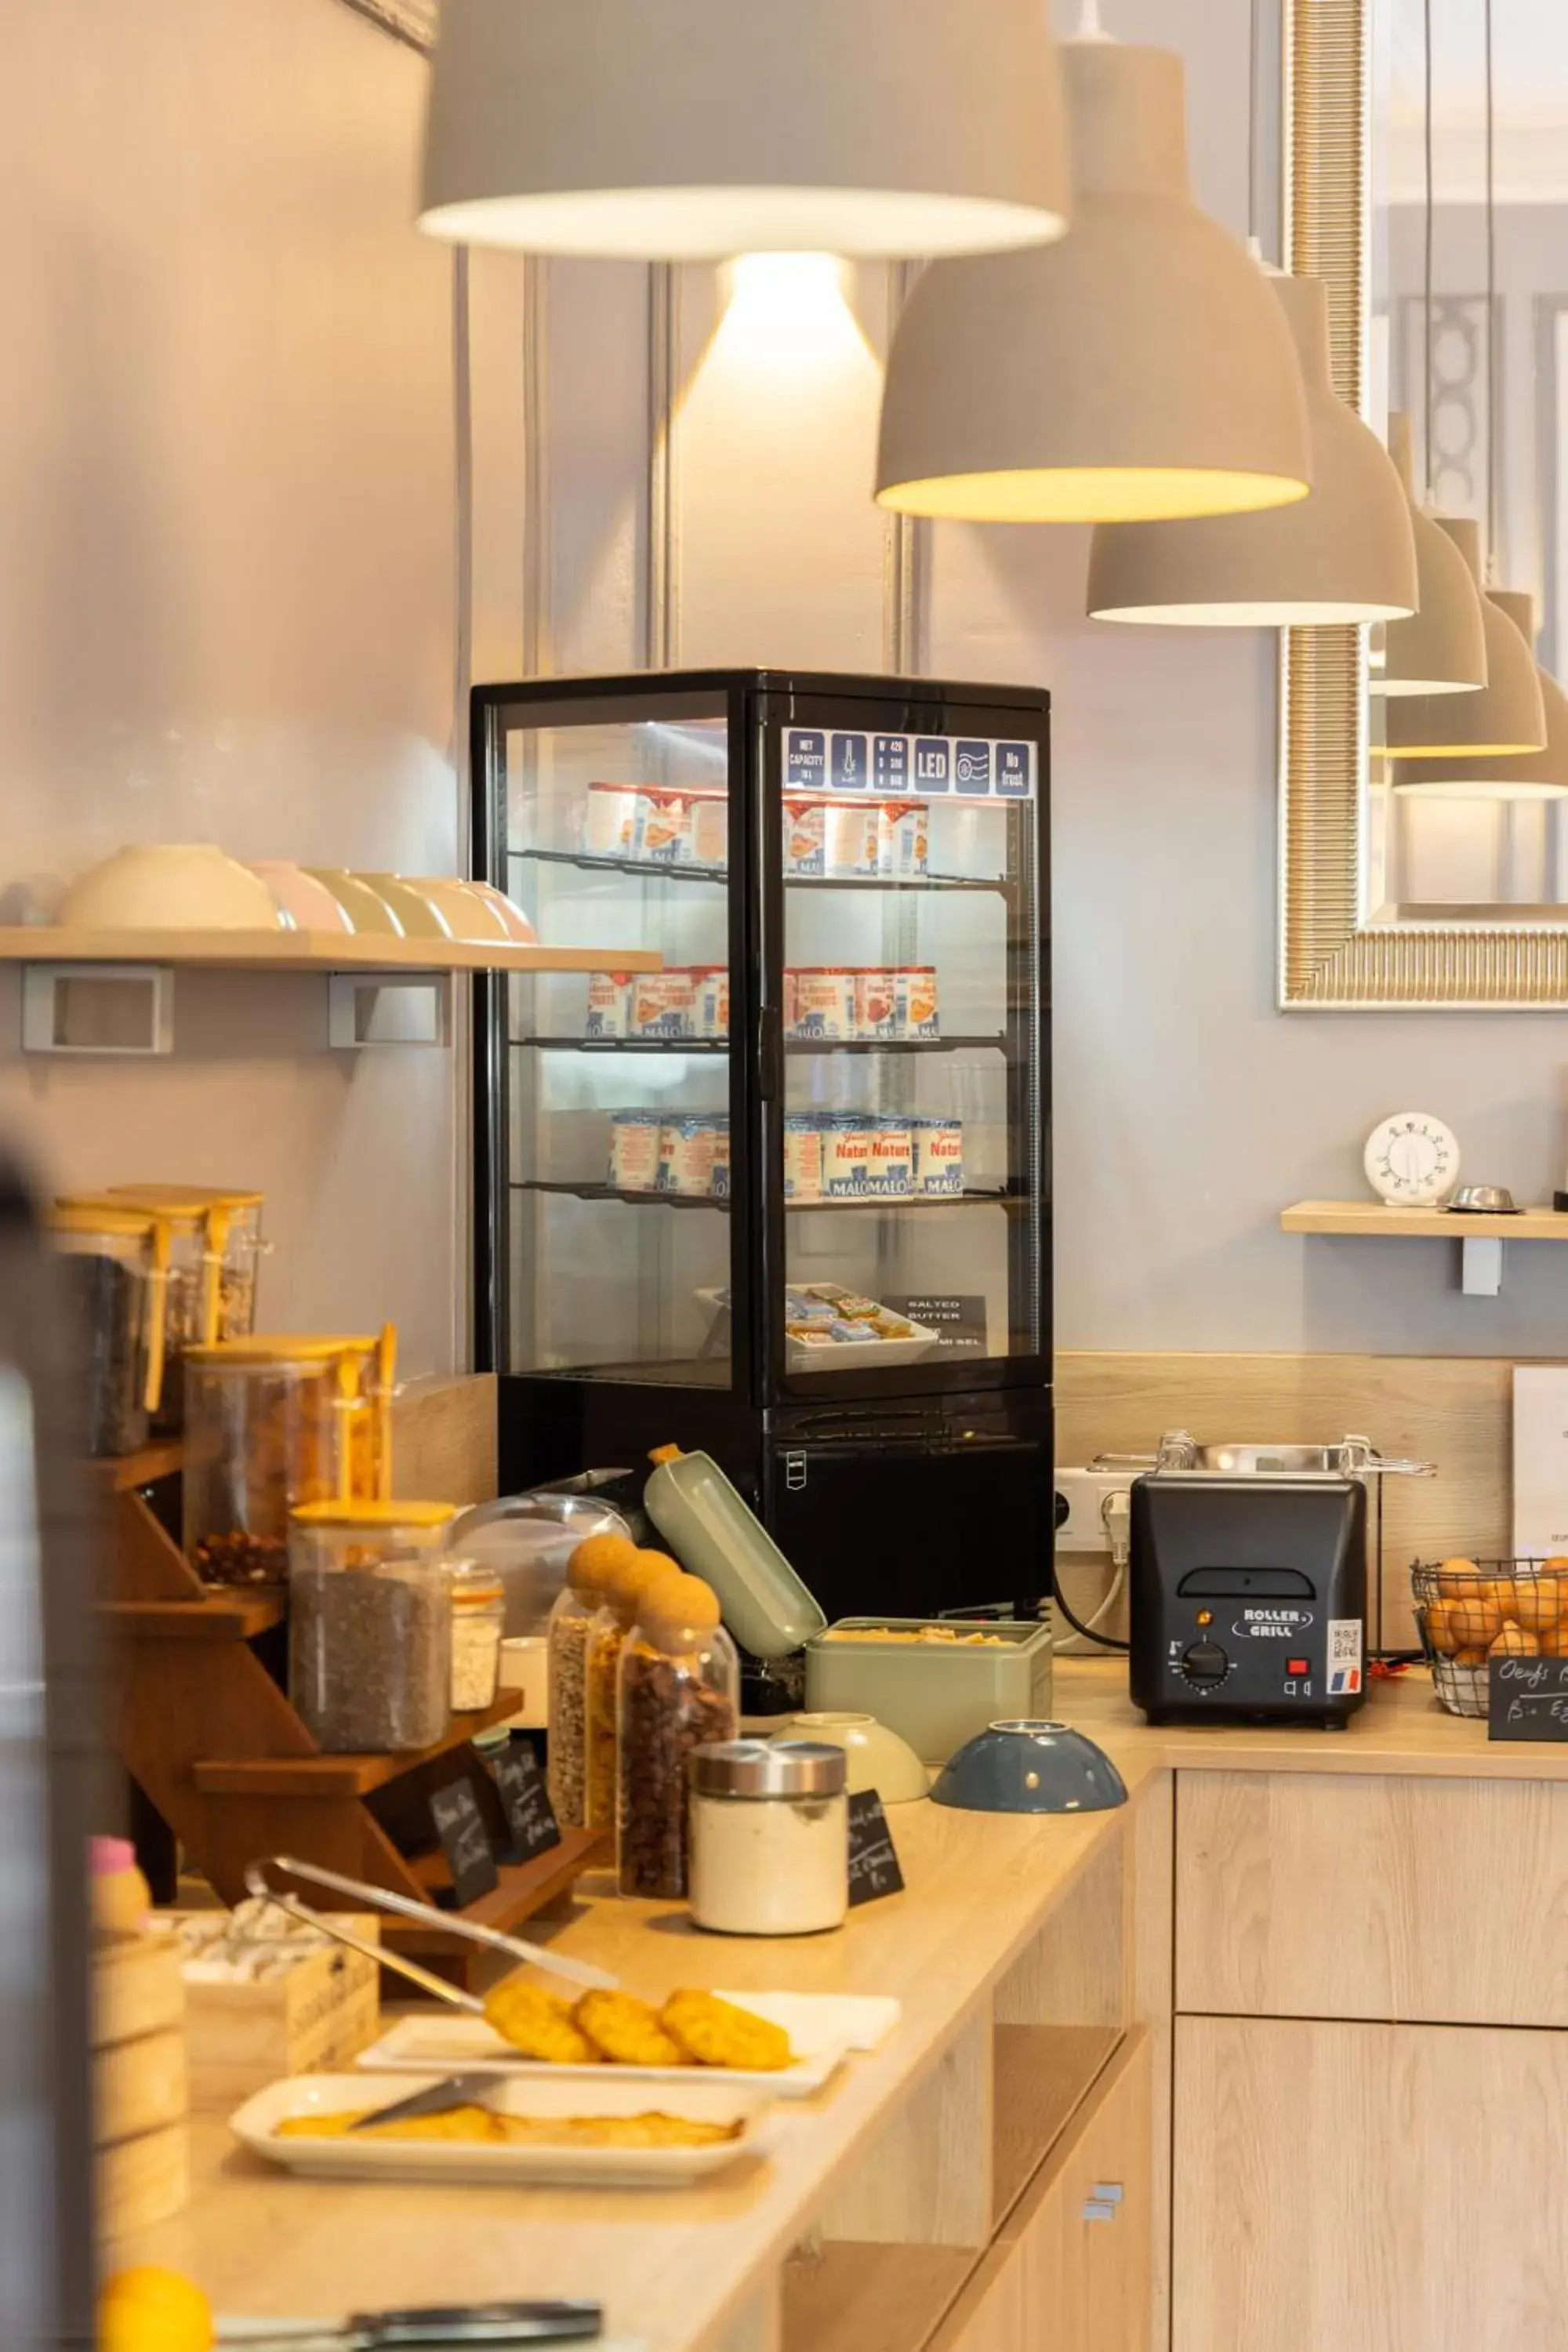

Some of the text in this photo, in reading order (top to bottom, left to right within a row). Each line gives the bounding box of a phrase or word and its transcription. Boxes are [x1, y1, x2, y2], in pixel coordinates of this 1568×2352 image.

[789, 754, 823, 766] CAPACITY
[918, 753, 946, 779] LED
[1006, 752, 1018, 768] No
[1001, 770, 1024, 787] frost
[868, 1178, 907, 1195] MALO
[907, 1300, 960, 1308] SALTED
[1244, 1609, 1300, 1622] ROLLER
[1250, 1625, 1293, 1638] GRILL
